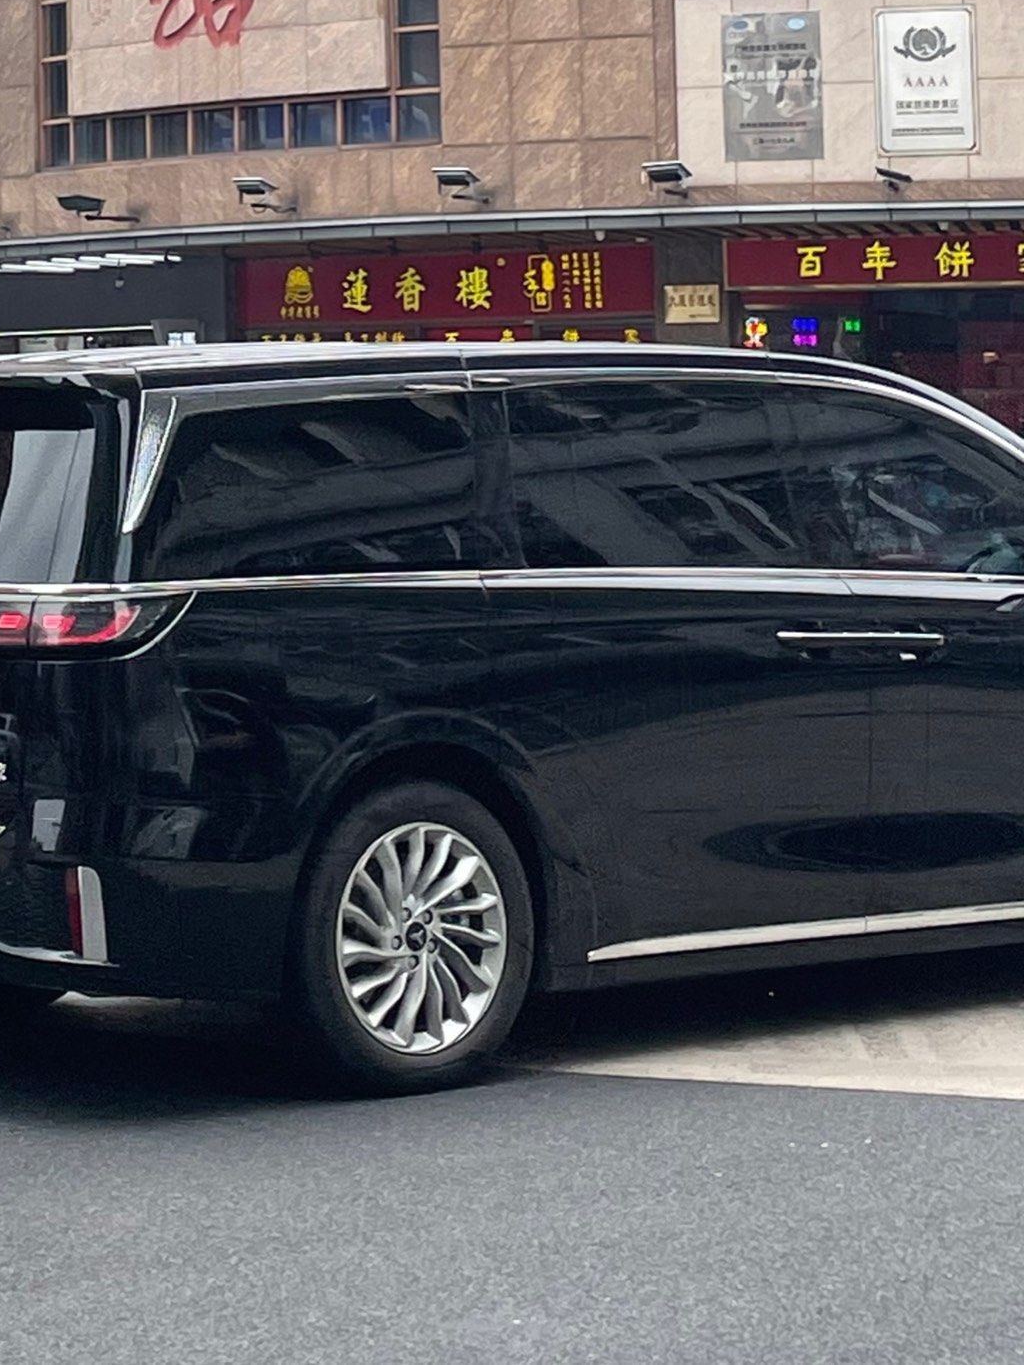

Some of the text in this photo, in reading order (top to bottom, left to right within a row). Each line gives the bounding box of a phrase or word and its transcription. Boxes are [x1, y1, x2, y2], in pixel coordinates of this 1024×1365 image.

[795, 240, 1024, 281] 百年餅
[341, 266, 493, 313] 蓮香樓
